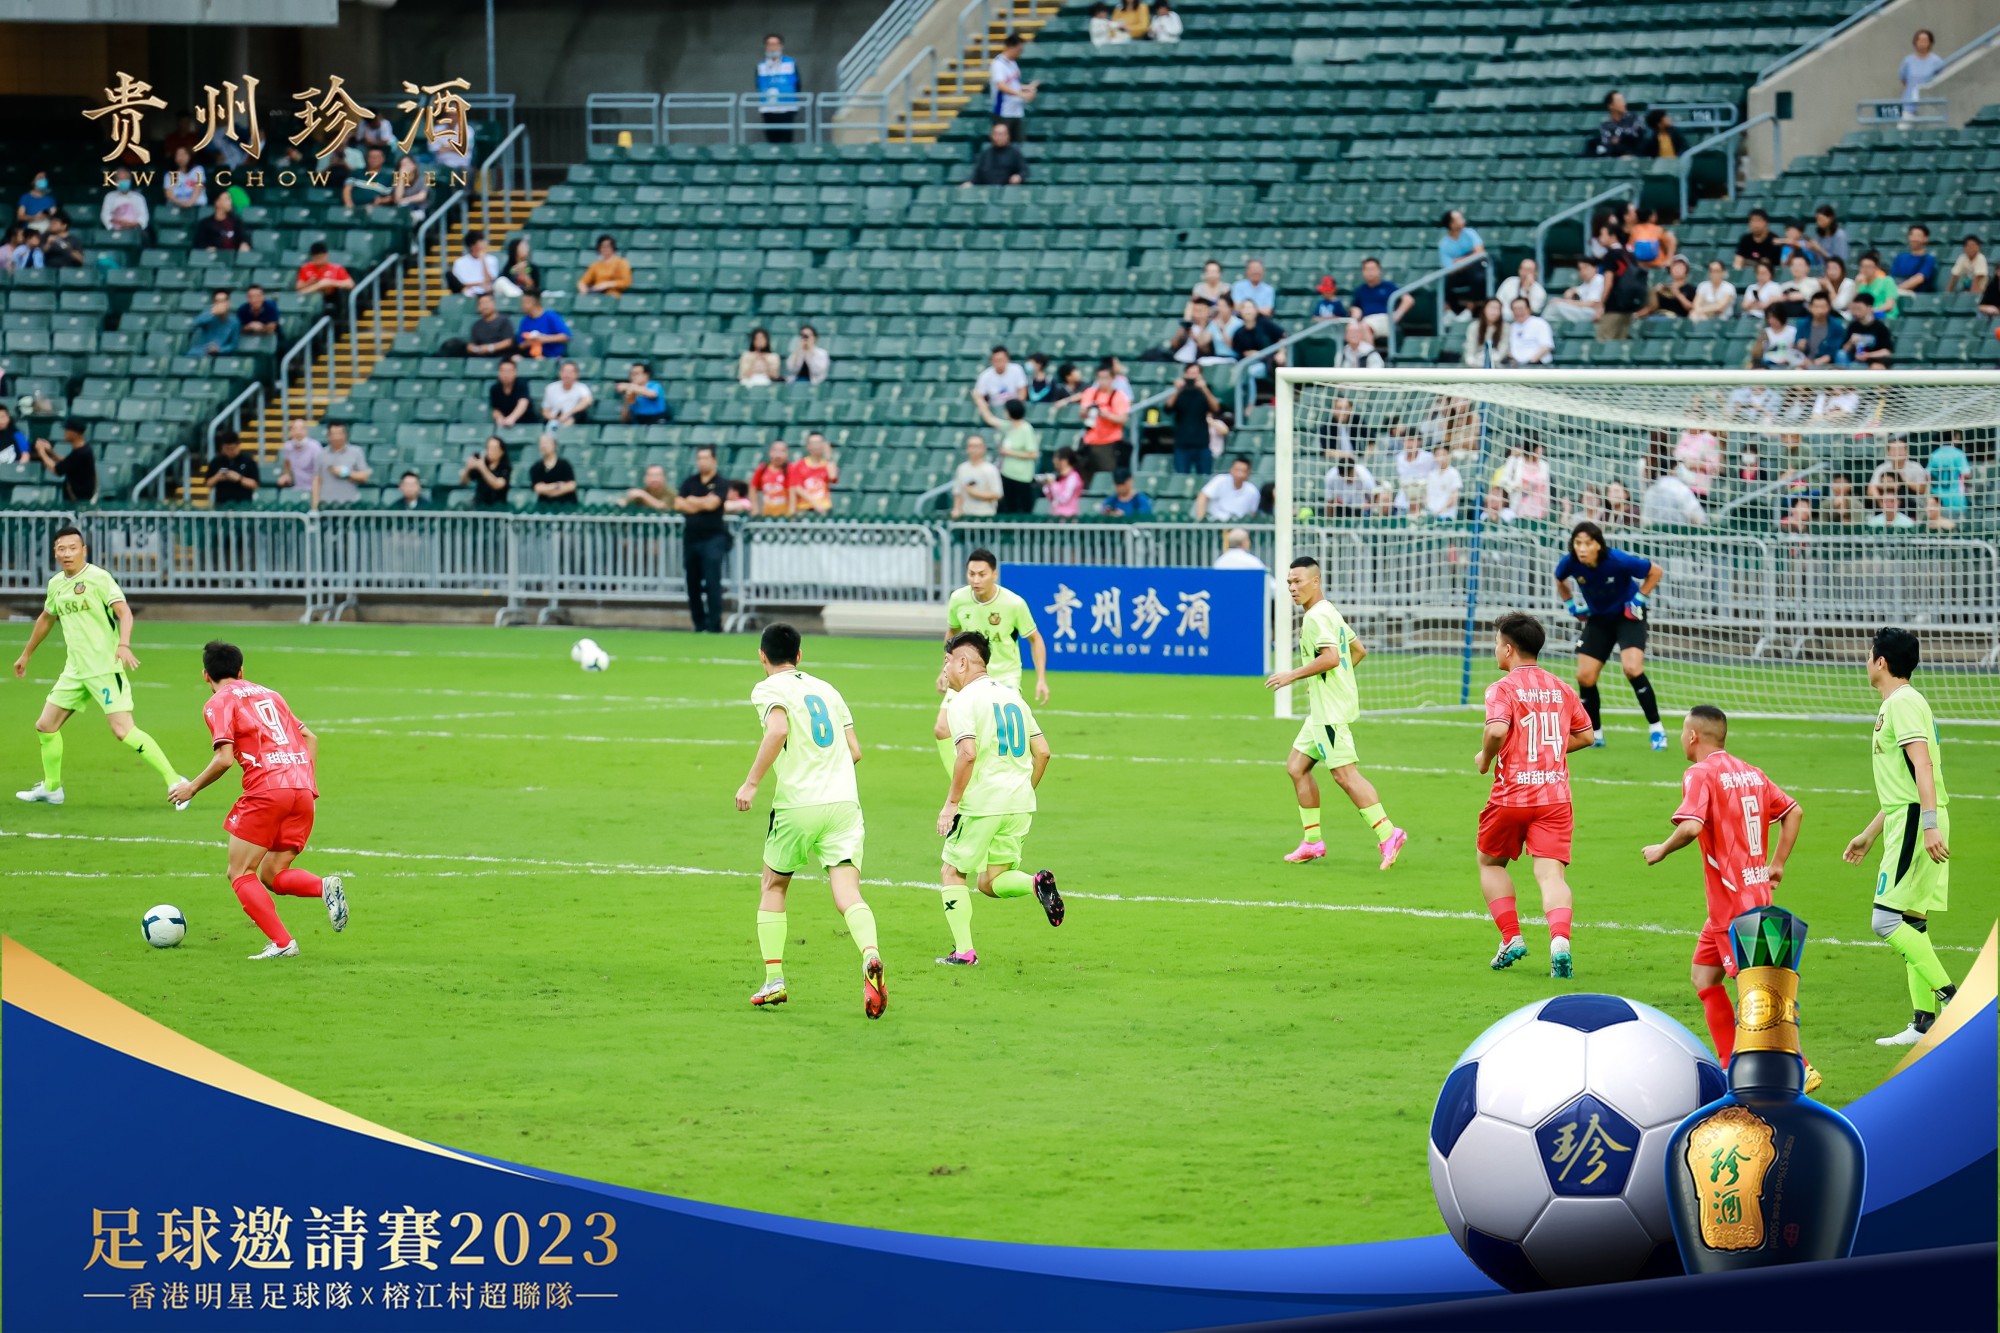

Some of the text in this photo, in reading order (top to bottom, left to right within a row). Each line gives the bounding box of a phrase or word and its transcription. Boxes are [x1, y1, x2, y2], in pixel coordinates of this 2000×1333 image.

[1053, 642, 1209, 657] KWEICHOW ZHEN
[102, 687, 113, 705] 2
[1516, 688, 1563, 704] 贵州村超
[254, 698, 289, 746] 9
[803, 694, 834, 748] 8
[992, 702, 1025, 758] 10
[1520, 711, 1563, 762] 14
[1741, 795, 1763, 857] 6
